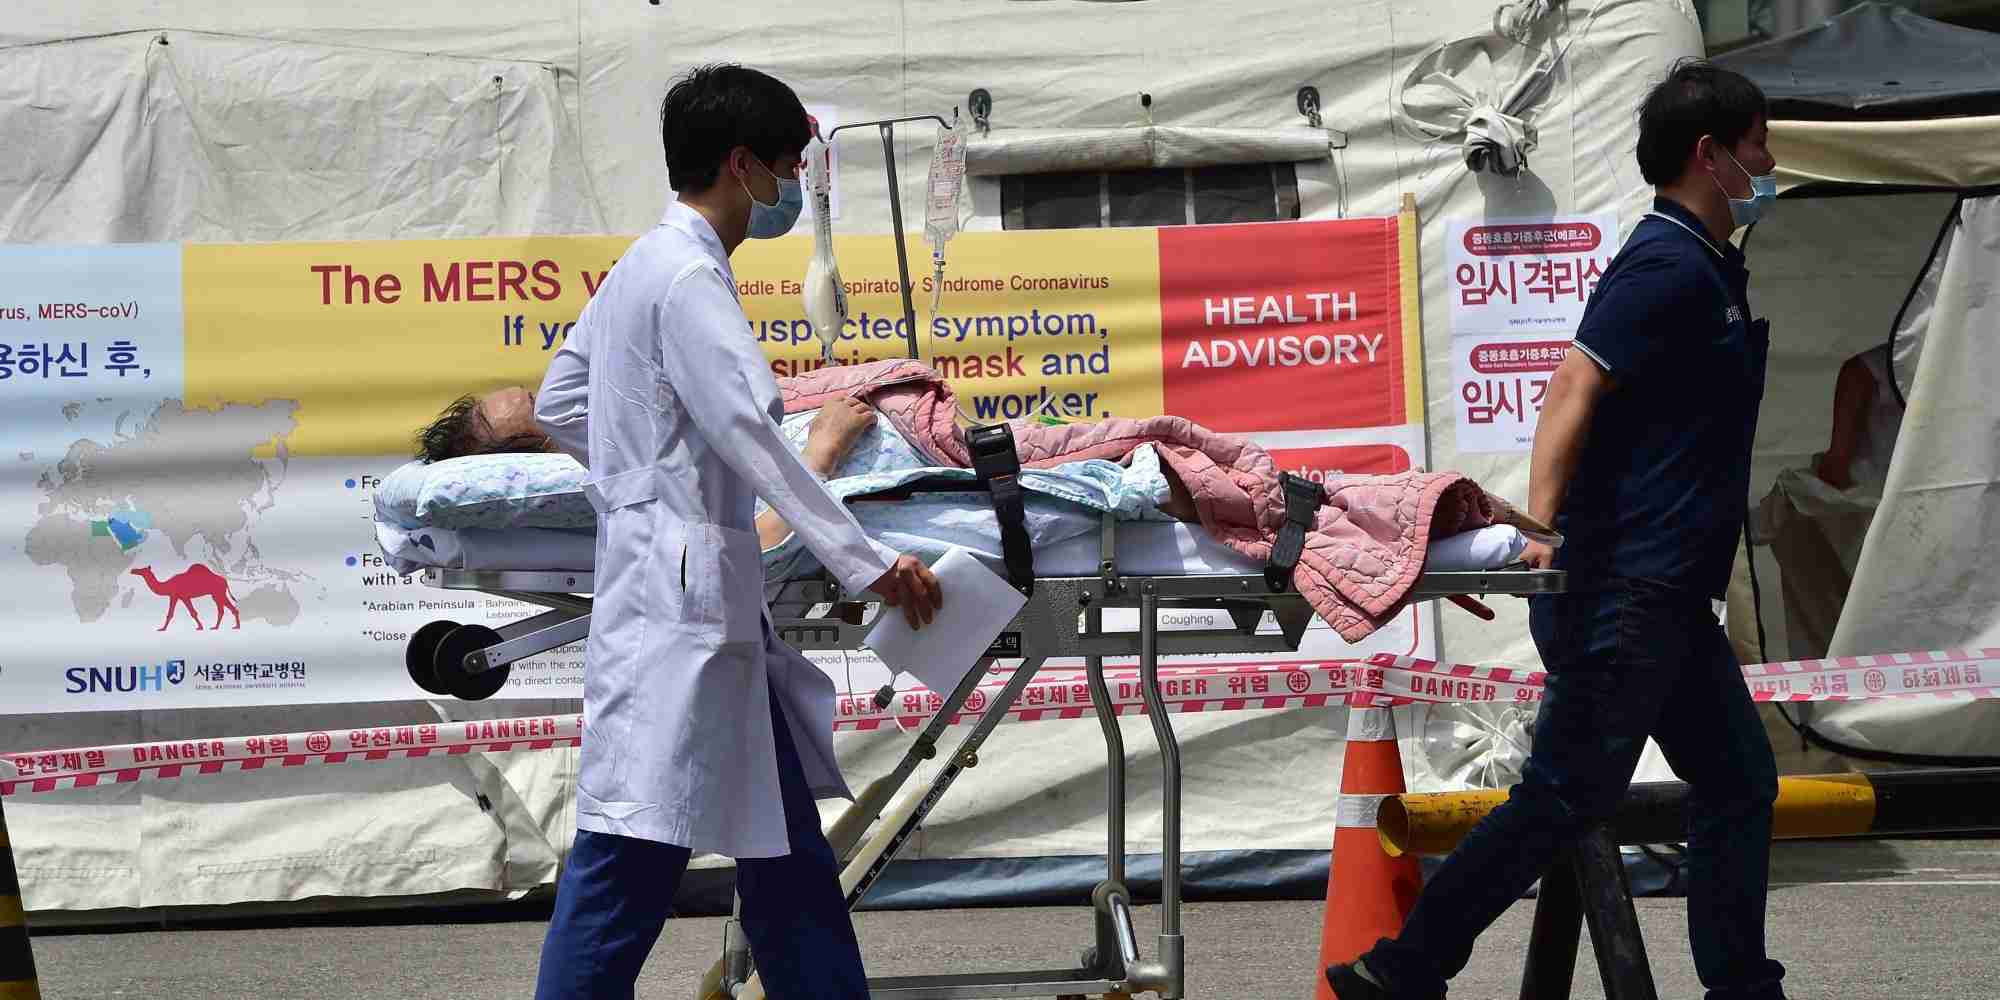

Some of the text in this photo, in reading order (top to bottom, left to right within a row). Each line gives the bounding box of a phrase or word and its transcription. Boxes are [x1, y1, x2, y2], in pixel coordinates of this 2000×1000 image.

[310, 264, 401, 304] The
[423, 260, 561, 302] MERS
[923, 276, 1004, 292] Sndrome
[1010, 273, 1110, 291] Coronavirus
[1456, 261, 1518, 305] 임시
[38, 300, 139, 319] MERS-coV)
[1205, 291, 1357, 326] HEALTH
[503, 315, 524, 346] If
[932, 309, 1108, 342] symptom,
[104, 340, 151, 378] 후,
[933, 346, 1026, 379] mask
[1041, 344, 1110, 376] and
[1182, 333, 1384, 369] ADVISORY
[974, 386, 1110, 419] worker.
[1462, 378, 1524, 425] 임시
[362, 573, 396, 587] with
[402, 576, 413, 585] a
[418, 599, 475, 611] Peninsula
[1161, 613, 1214, 626] Coughing
[194, 661, 305, 682] 서울대학교병원
[518, 660, 546, 671] within
[550, 660, 566, 669] the
[65, 666, 162, 694] SNUH
[525, 676, 552, 685] direct
[1118, 678, 1208, 699] DAGER
[1410, 675, 1497, 702] DANGER
[349, 725, 439, 748] 안전제일
[465, 718, 556, 740] DANGER
[133, 741, 225, 763] DANGER
[245, 735, 289, 756] 위험
[14, 749, 105, 777] 안전제일
